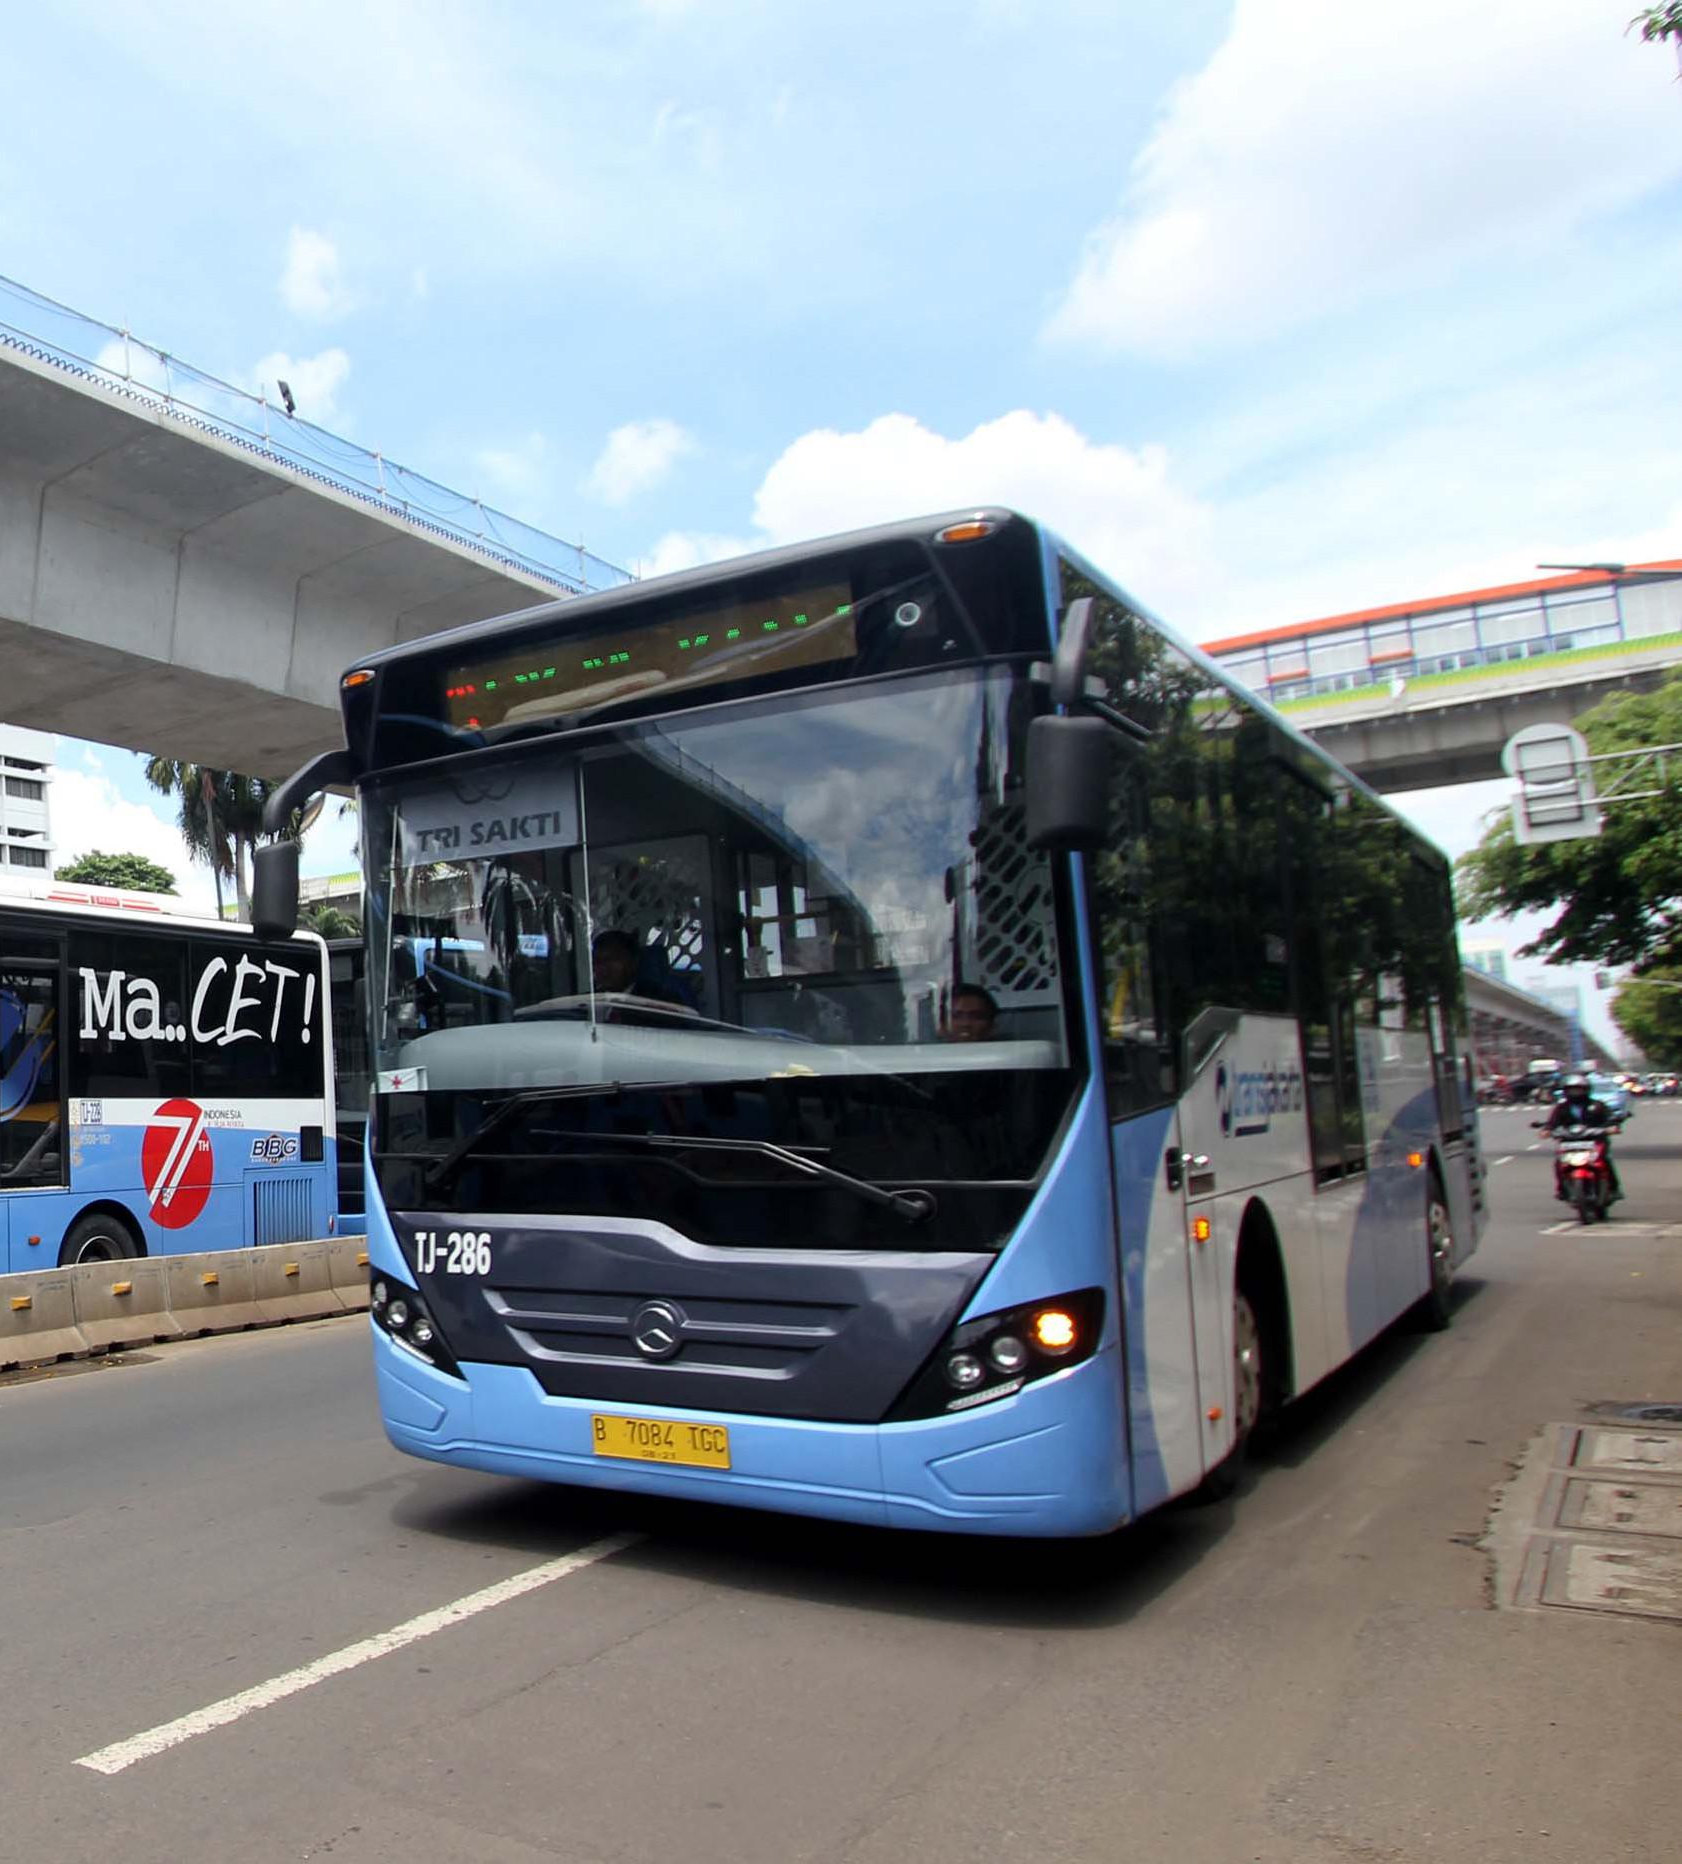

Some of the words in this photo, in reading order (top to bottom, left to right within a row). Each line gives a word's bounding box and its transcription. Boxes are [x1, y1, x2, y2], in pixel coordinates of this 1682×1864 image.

[416, 826, 461, 852] TRI
[470, 811, 561, 846] SAKTI
[80, 1102, 102, 1123] TJ-228
[250, 1136, 298, 1159] BBG
[415, 1232, 492, 1276] TJ-286
[594, 1418, 606, 1441] B
[626, 1420, 674, 1448] 7084
[688, 1426, 726, 1453] TGC
